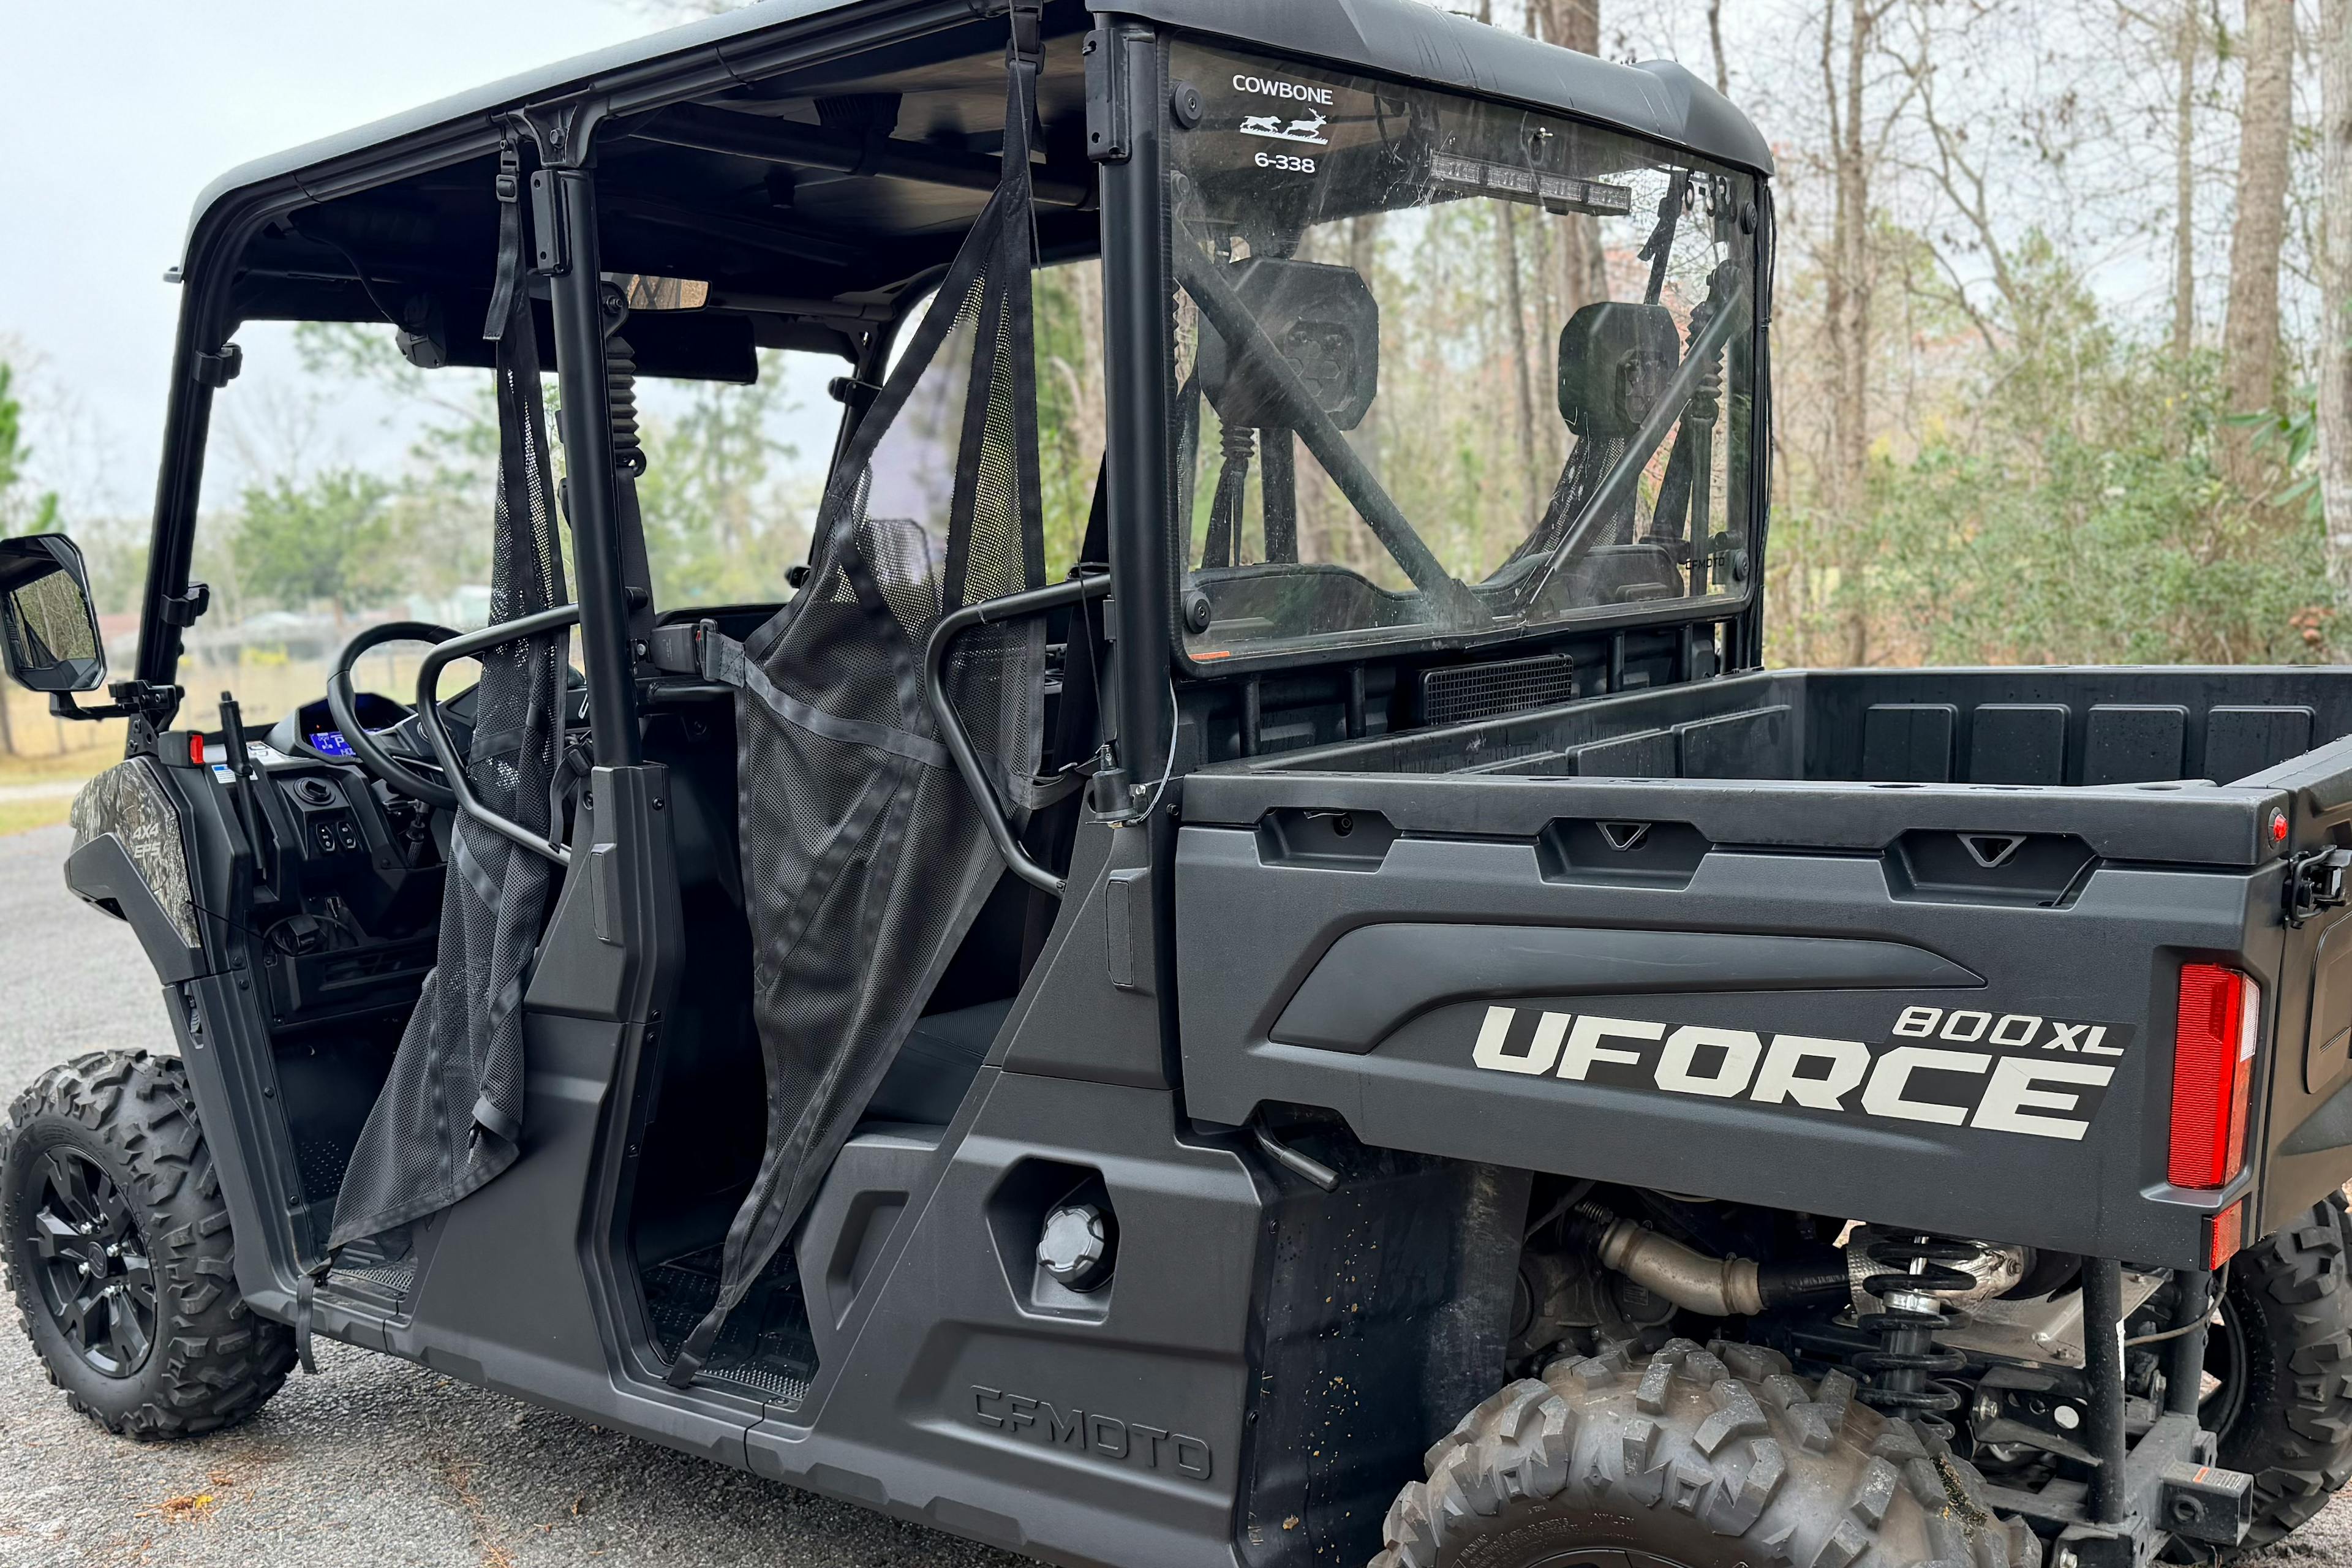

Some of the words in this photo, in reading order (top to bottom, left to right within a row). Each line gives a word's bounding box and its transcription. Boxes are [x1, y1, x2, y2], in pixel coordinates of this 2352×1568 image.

[1232, 74, 1333, 105] COWBONE
[1254, 152, 1316, 173] 6-338
[334, 736, 344, 747] P
[133, 823, 159, 840] 4X4
[134, 842, 161, 858] EPS
[1892, 1006, 2043, 1047] 800
[2041, 1022, 2125, 1056] XL
[1472, 1005, 2116, 1140] UFORCE
[970, 1384, 1212, 1480] CFMOTO
